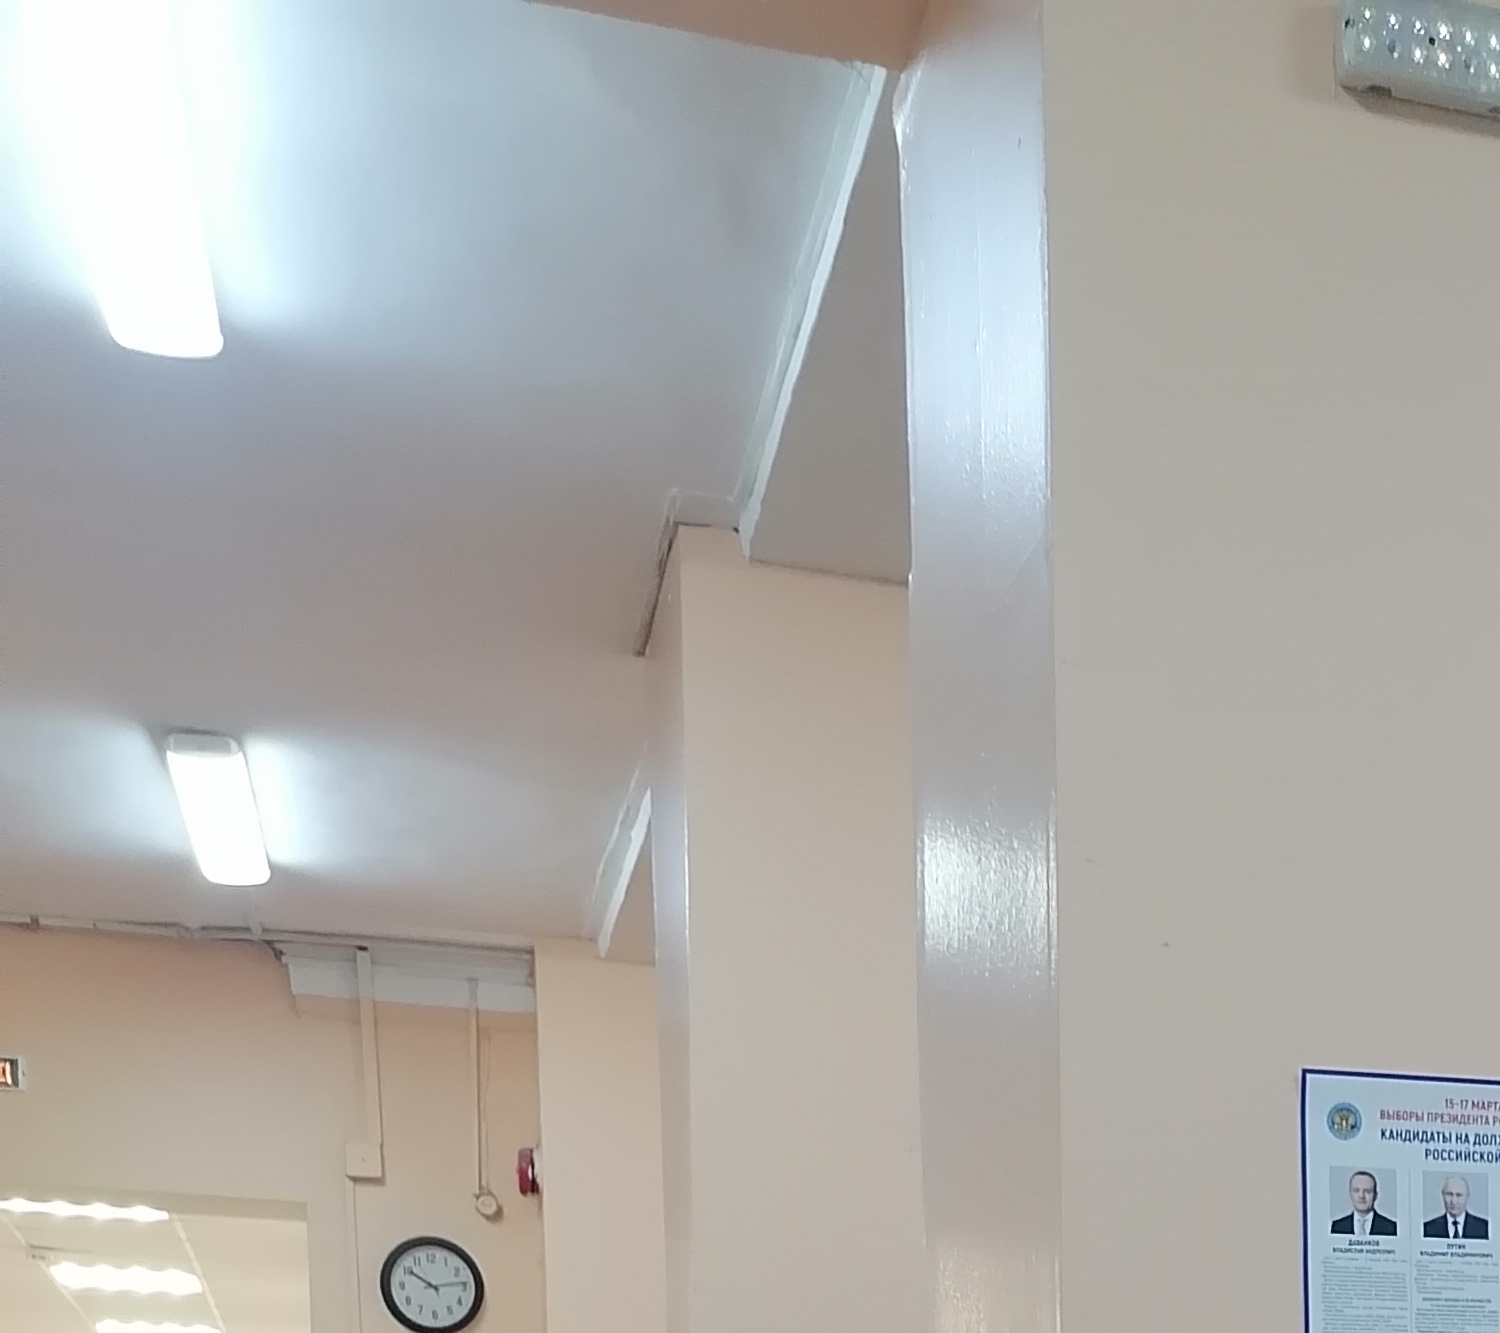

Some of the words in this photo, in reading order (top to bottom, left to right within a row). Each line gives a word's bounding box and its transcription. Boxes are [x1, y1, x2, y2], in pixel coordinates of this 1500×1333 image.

[1444, 1098, 1469, 1110] 15-17
[1379, 1109, 1425, 1122] ВЫБОРЫ
[1426, 1112, 1490, 1126] ПРЕЗИДЕНТА
[1380, 1128, 1453, 1145] КАНДИДАТЫ
[1455, 1132, 1471, 1145] НА
